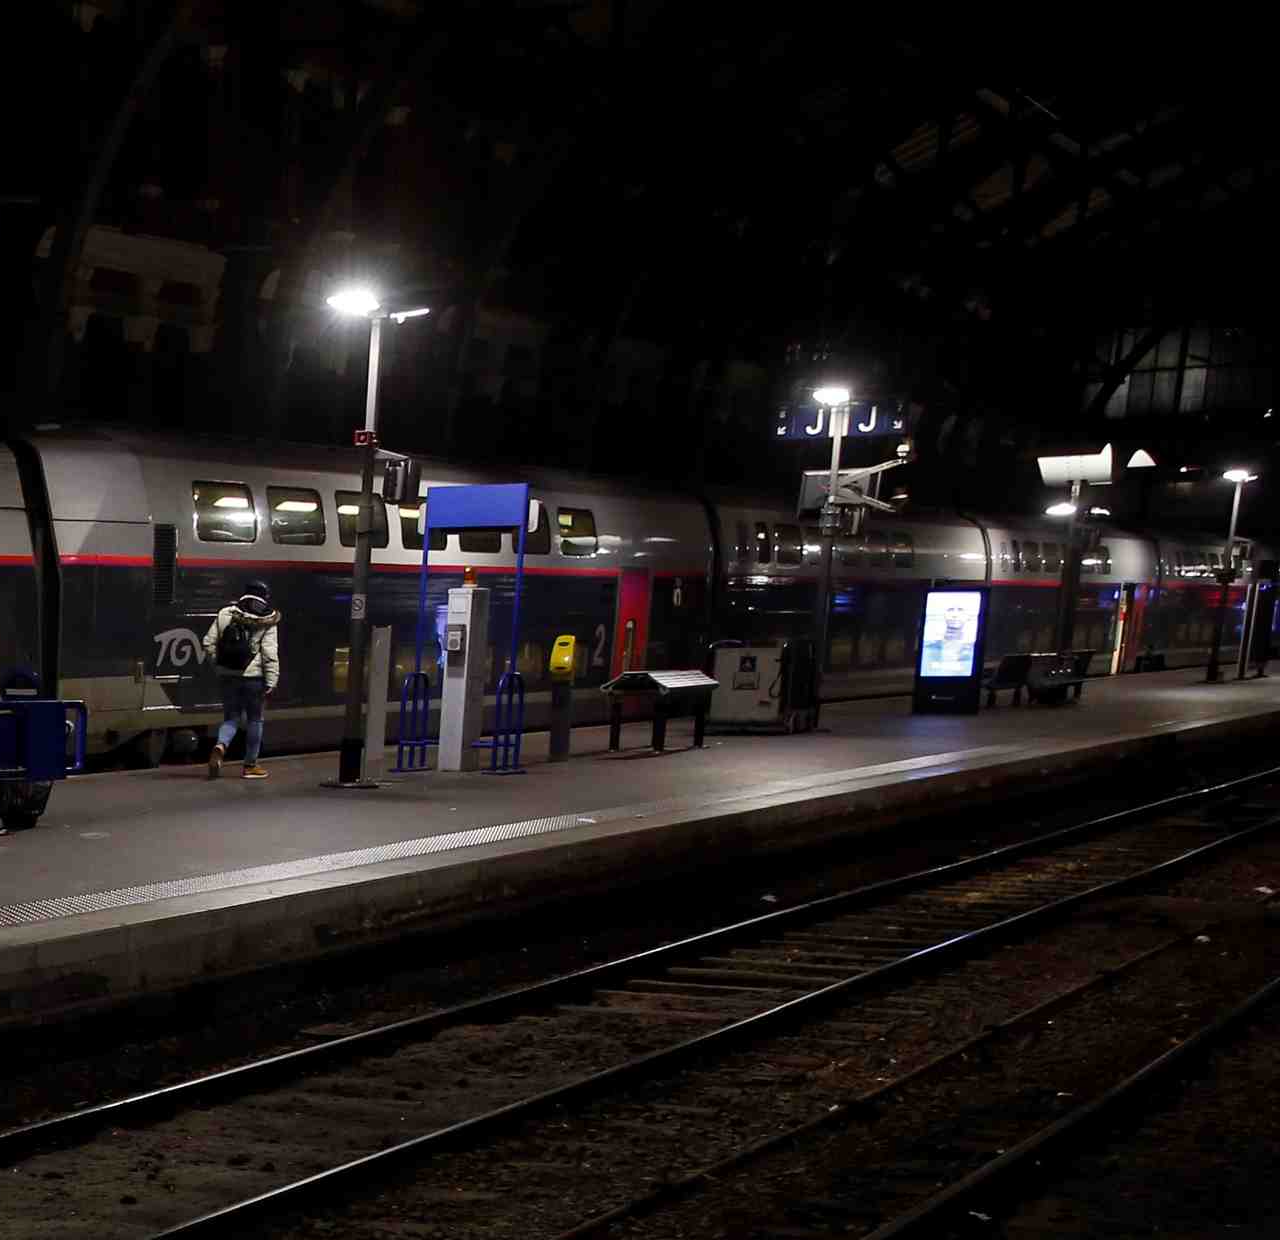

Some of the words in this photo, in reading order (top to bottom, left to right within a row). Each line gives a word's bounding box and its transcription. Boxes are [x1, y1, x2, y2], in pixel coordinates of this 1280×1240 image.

[805, 408, 824, 435] J
[858, 406, 877, 432] J
[153, 628, 206, 667] TGV
